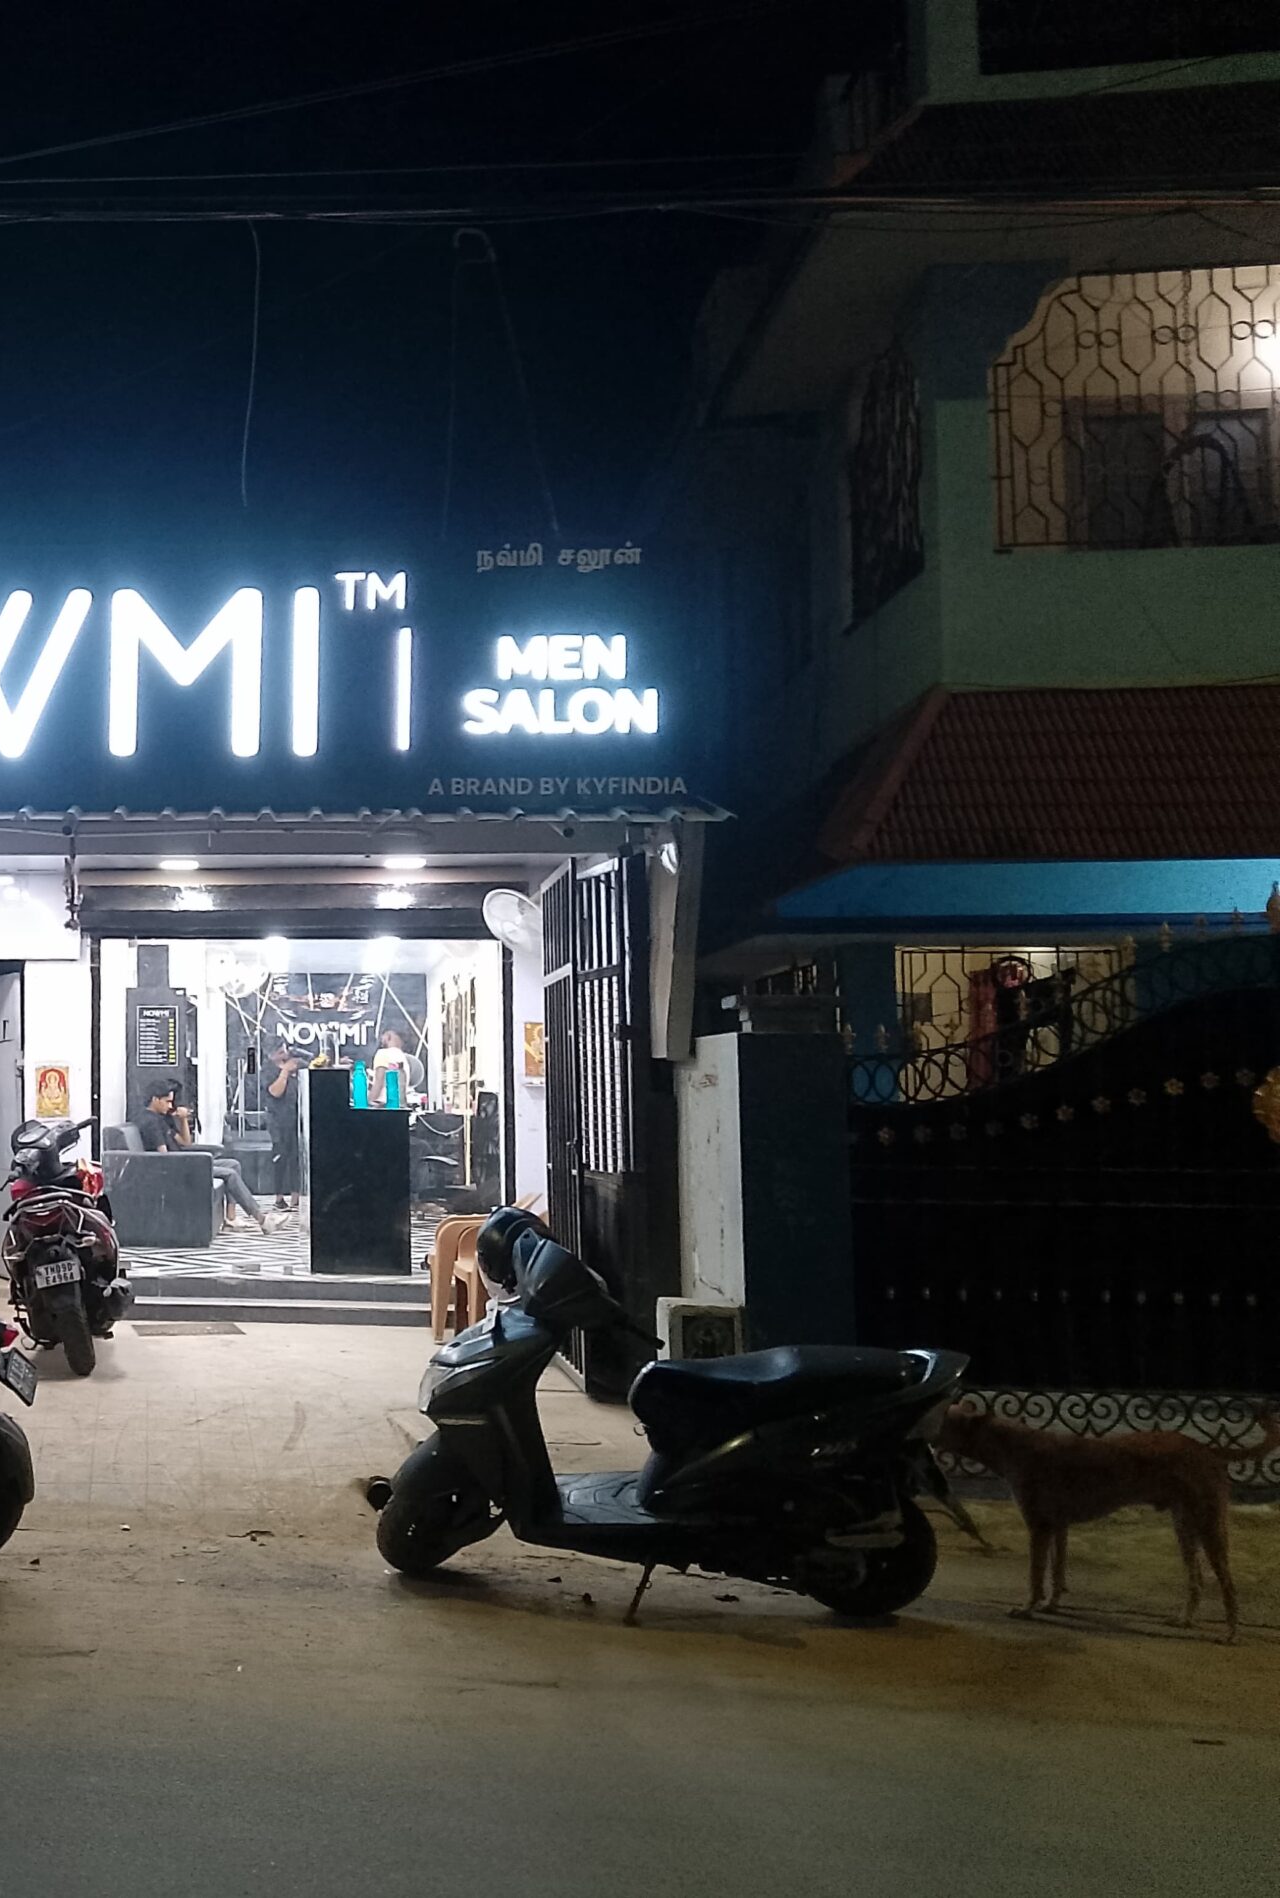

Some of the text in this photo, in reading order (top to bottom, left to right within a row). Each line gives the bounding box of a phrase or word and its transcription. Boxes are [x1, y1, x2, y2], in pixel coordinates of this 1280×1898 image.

[476, 541, 642, 573] நவ்மி சலூன்
[335, 571, 407, 610] TM
[496, 634, 627, 681] MEN
[463, 687, 659, 735] SALON
[428, 777, 688, 796] A BRAND BY KYFINDIA
